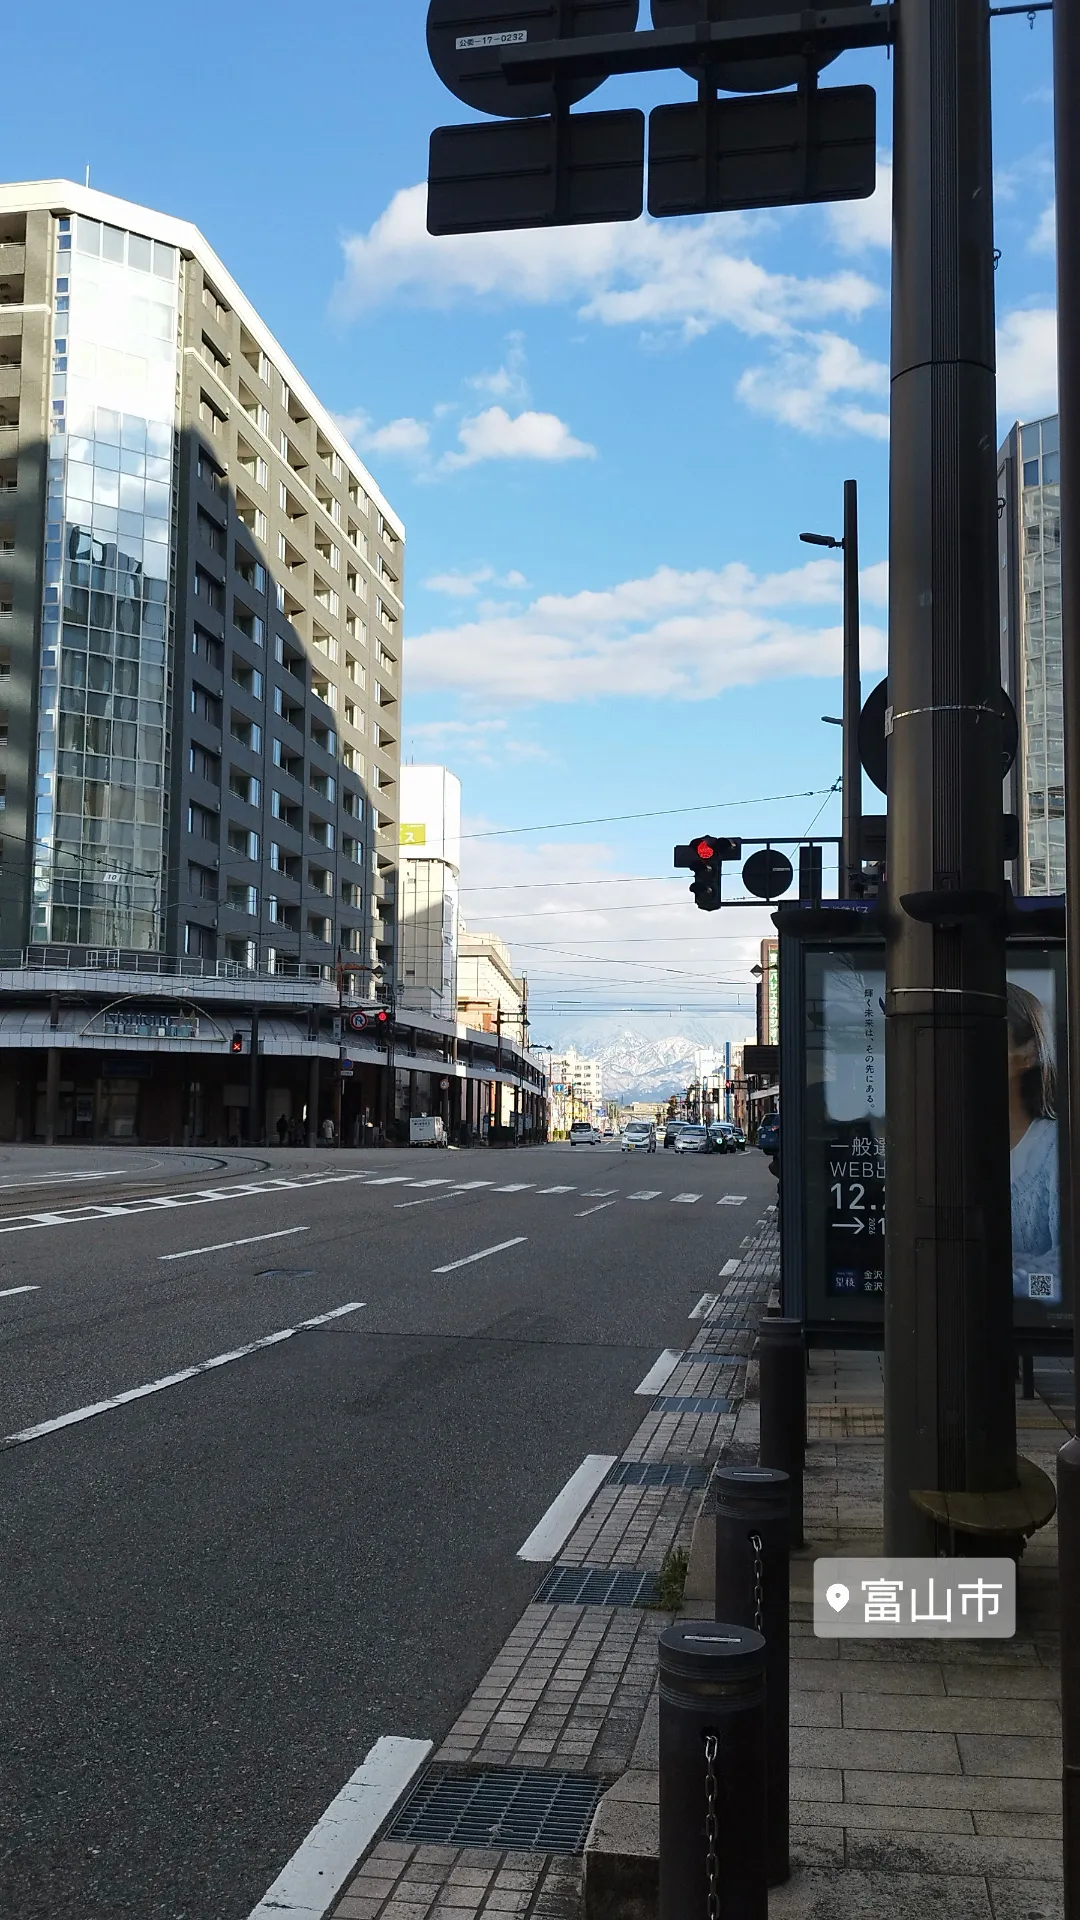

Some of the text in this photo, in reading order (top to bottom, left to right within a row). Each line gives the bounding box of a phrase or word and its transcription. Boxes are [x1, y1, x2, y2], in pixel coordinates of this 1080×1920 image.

[864, 988, 875, 1108] 輝く未来は、その先にある。
[830, 1182, 886, 1211] 12.
[863, 1270, 885, 1280] 金沢
[863, 1281, 885, 1291] 金沢
